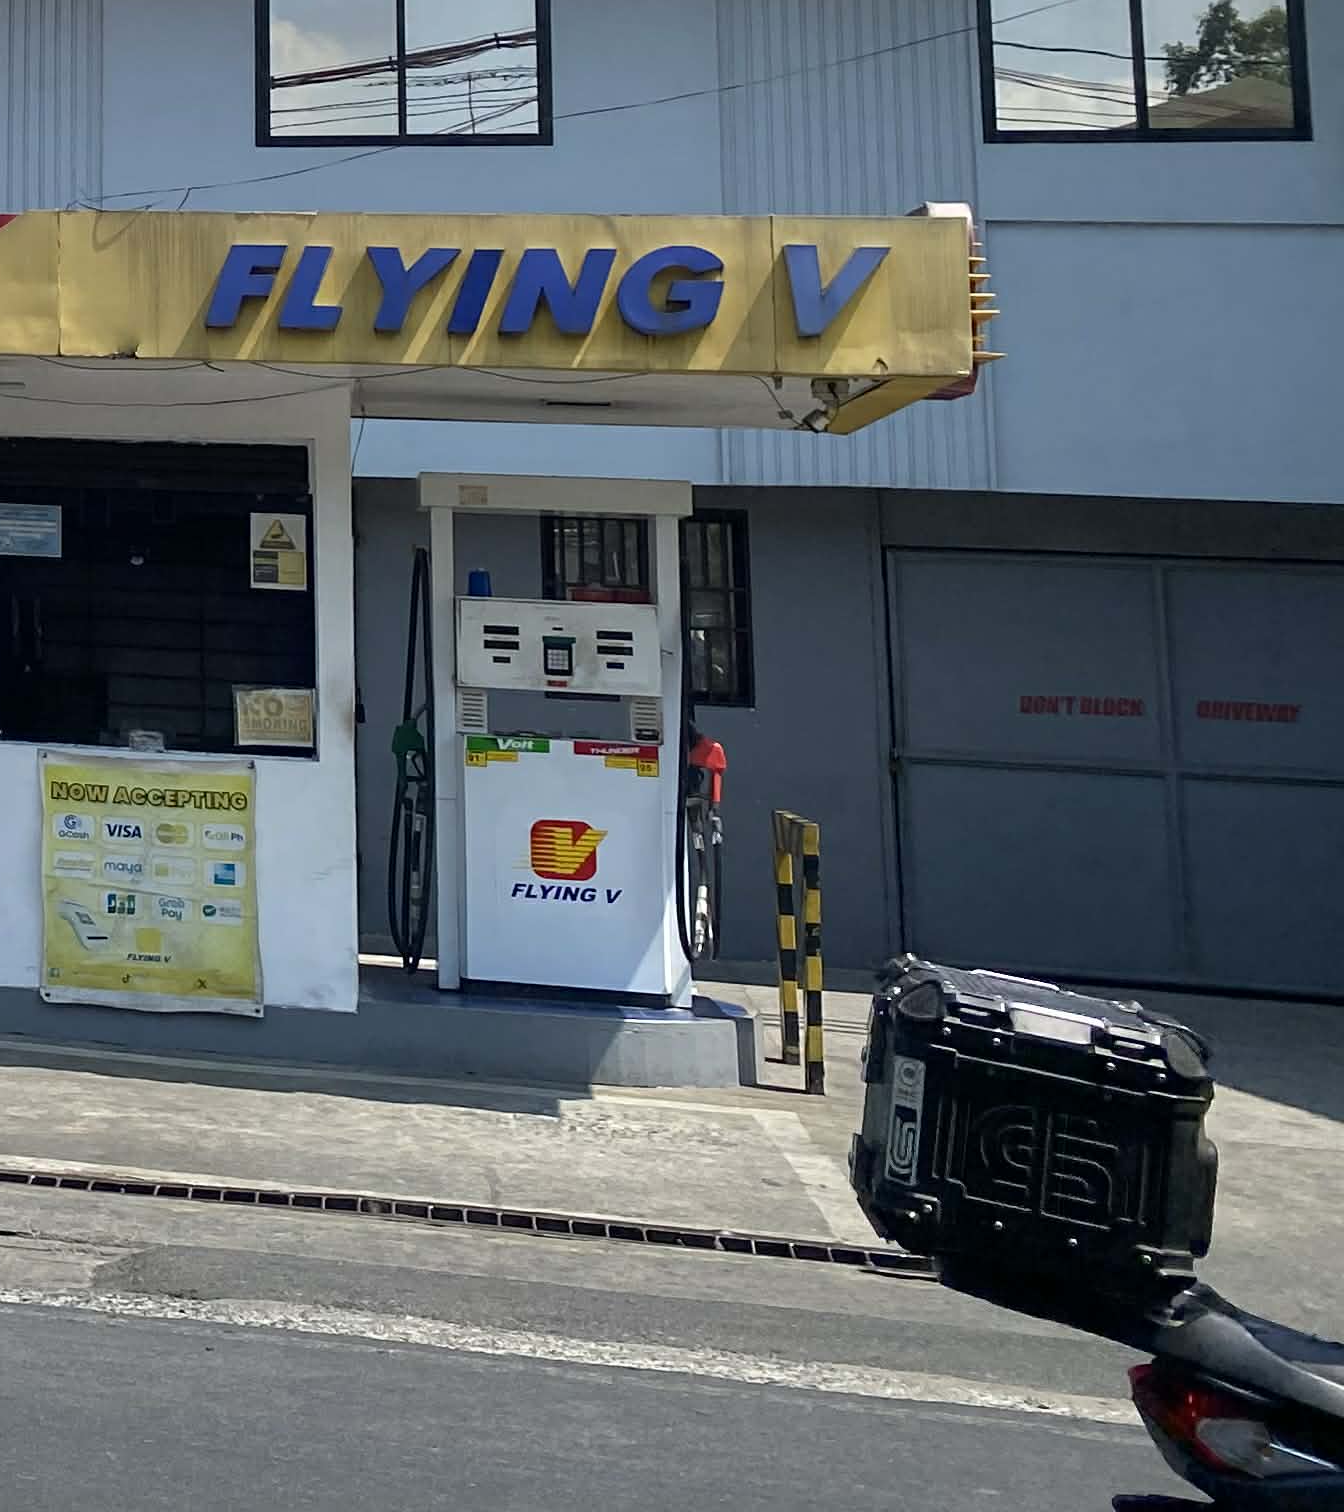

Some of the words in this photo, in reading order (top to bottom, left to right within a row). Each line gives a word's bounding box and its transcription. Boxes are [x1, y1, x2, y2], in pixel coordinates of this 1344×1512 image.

[205, 243, 724, 336] FLYING
[781, 244, 892, 338] V
[496, 737, 535, 751] Volt
[50, 781, 110, 803] NOW
[112, 786, 249, 811] ACCEPTING
[105, 823, 143, 839] VISA
[103, 862, 143, 875] maya
[510, 883, 597, 903] FLYING
[601, 888, 624, 905] V
[161, 909, 183, 921] Pay
[126, 952, 161, 963] FLYING
[162, 954, 172, 964] V
